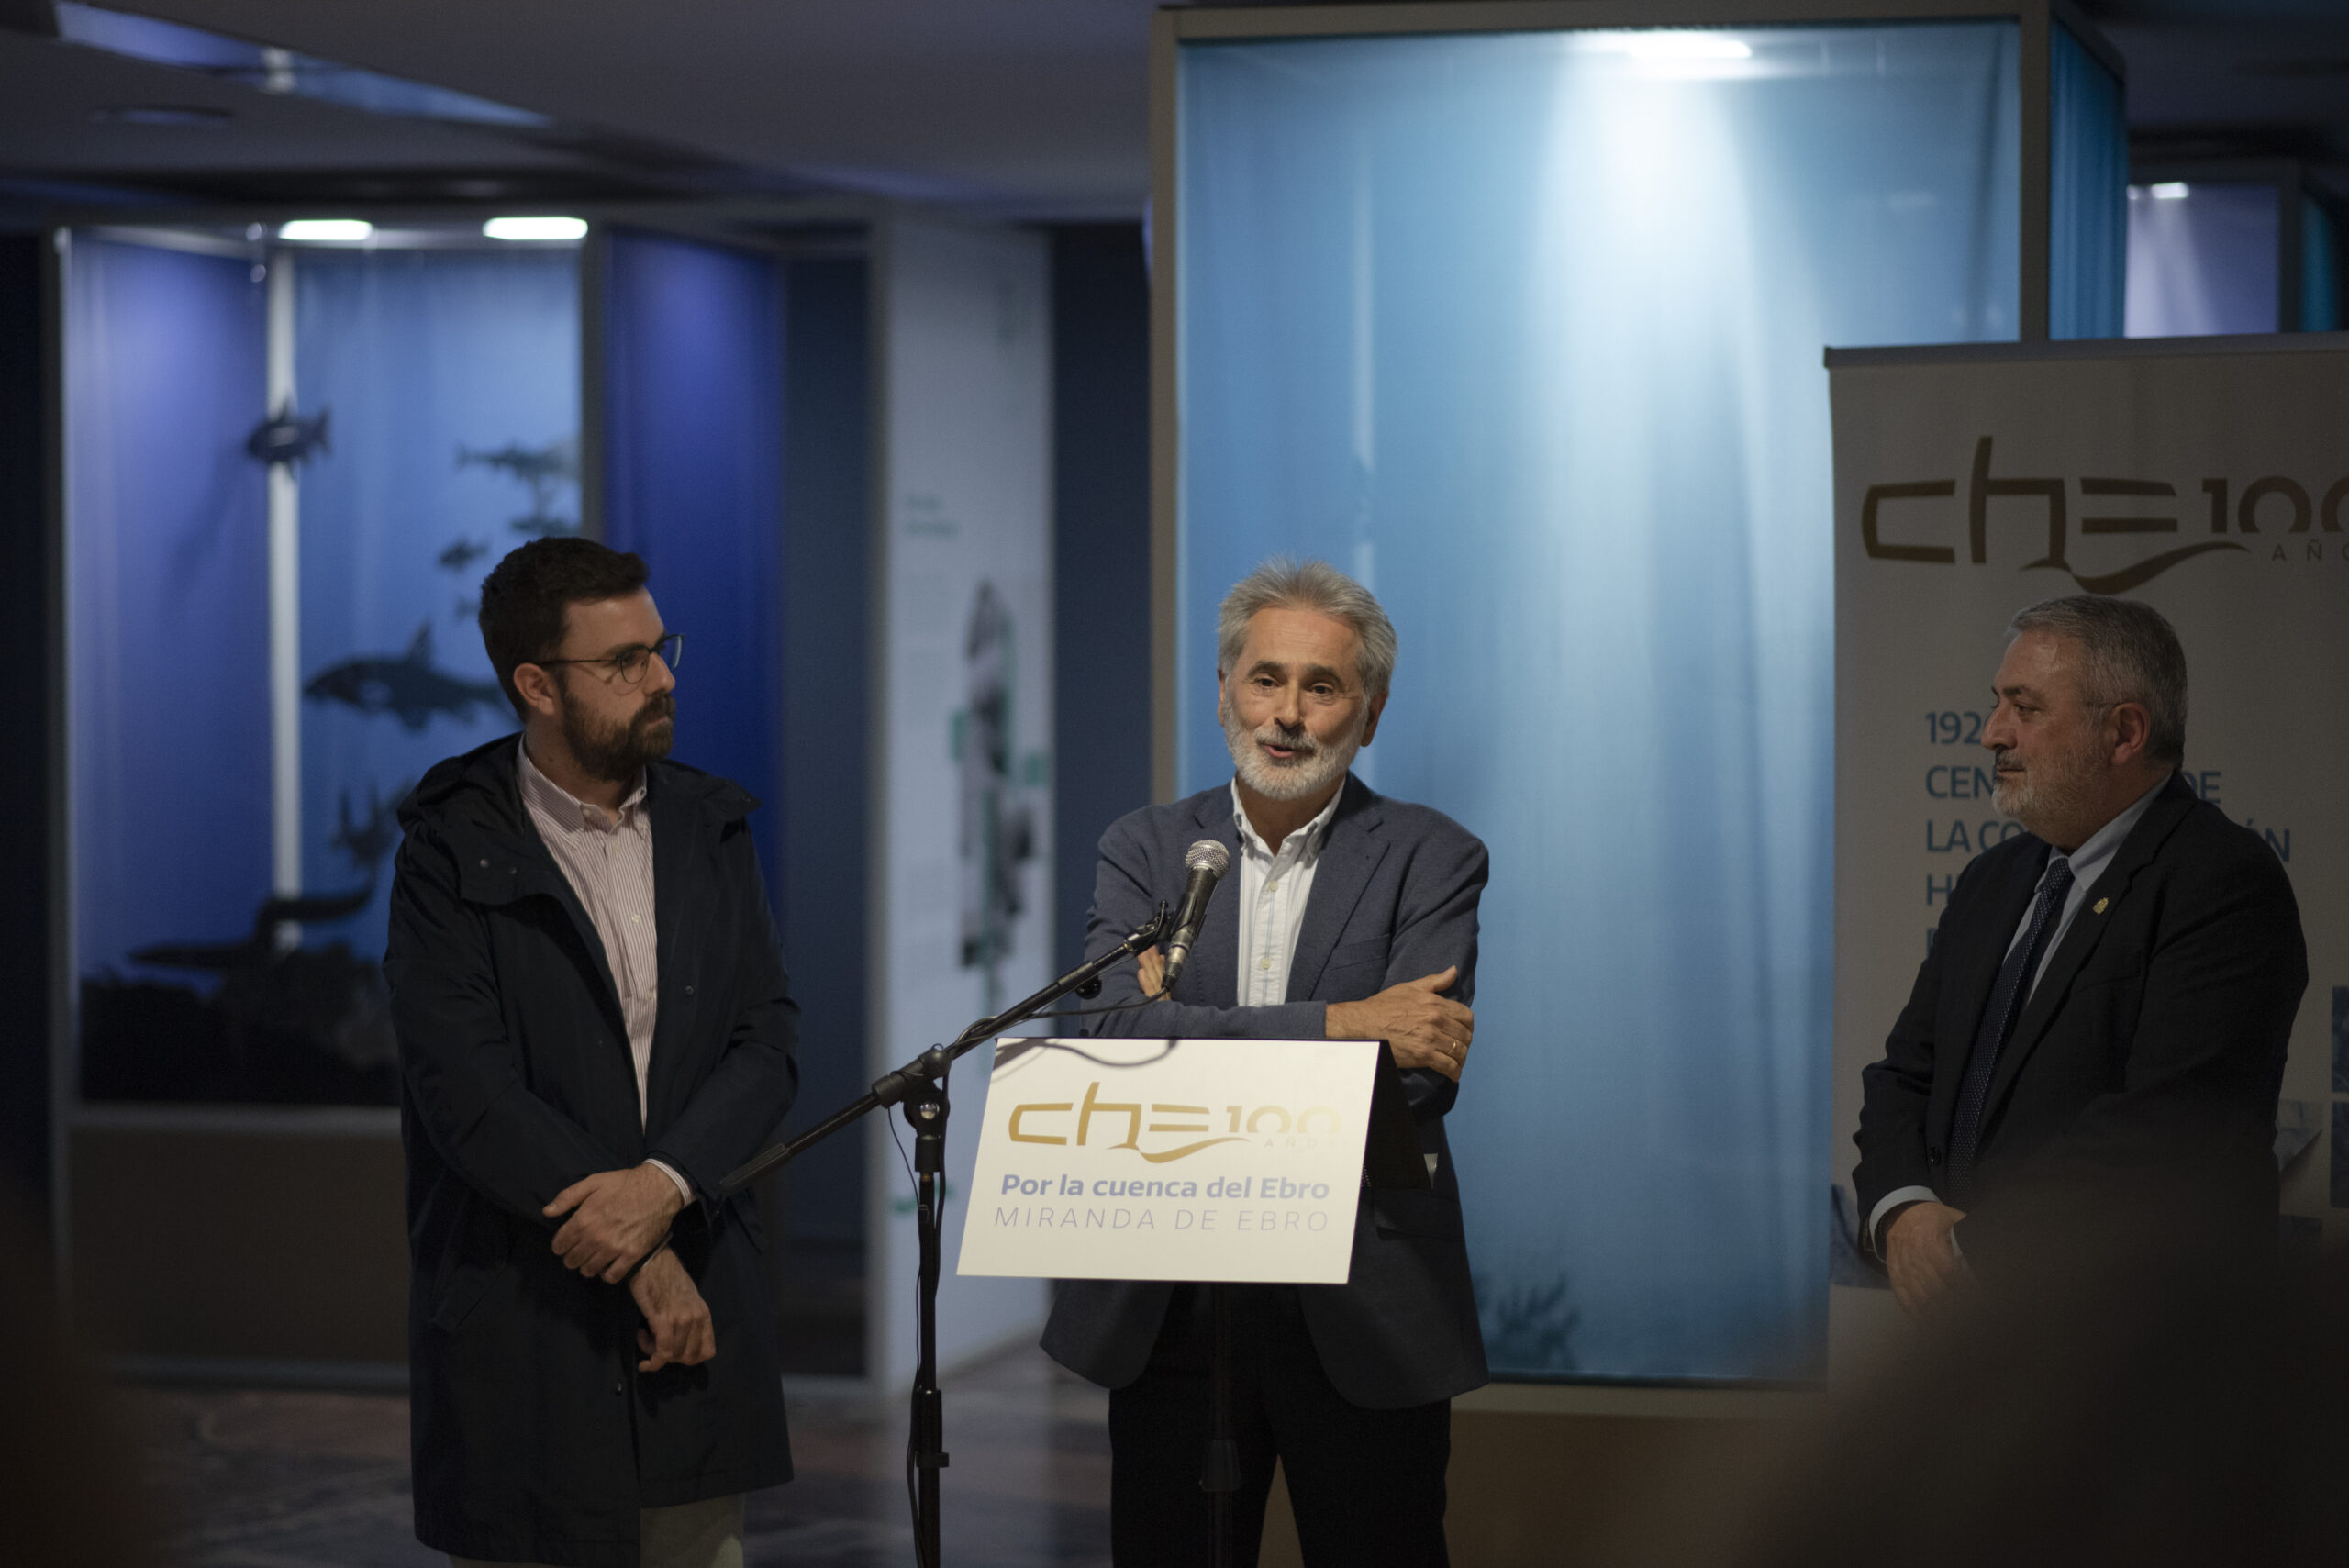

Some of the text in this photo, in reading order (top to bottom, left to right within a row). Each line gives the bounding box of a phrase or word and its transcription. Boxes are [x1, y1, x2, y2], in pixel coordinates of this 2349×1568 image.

[1925, 711, 1987, 744] 192
[1926, 820, 1970, 852] LA
[1001, 1173, 1330, 1199] Por la cuenca del Ebro
[995, 1207, 1329, 1232] MIRANDA DE EBRO
